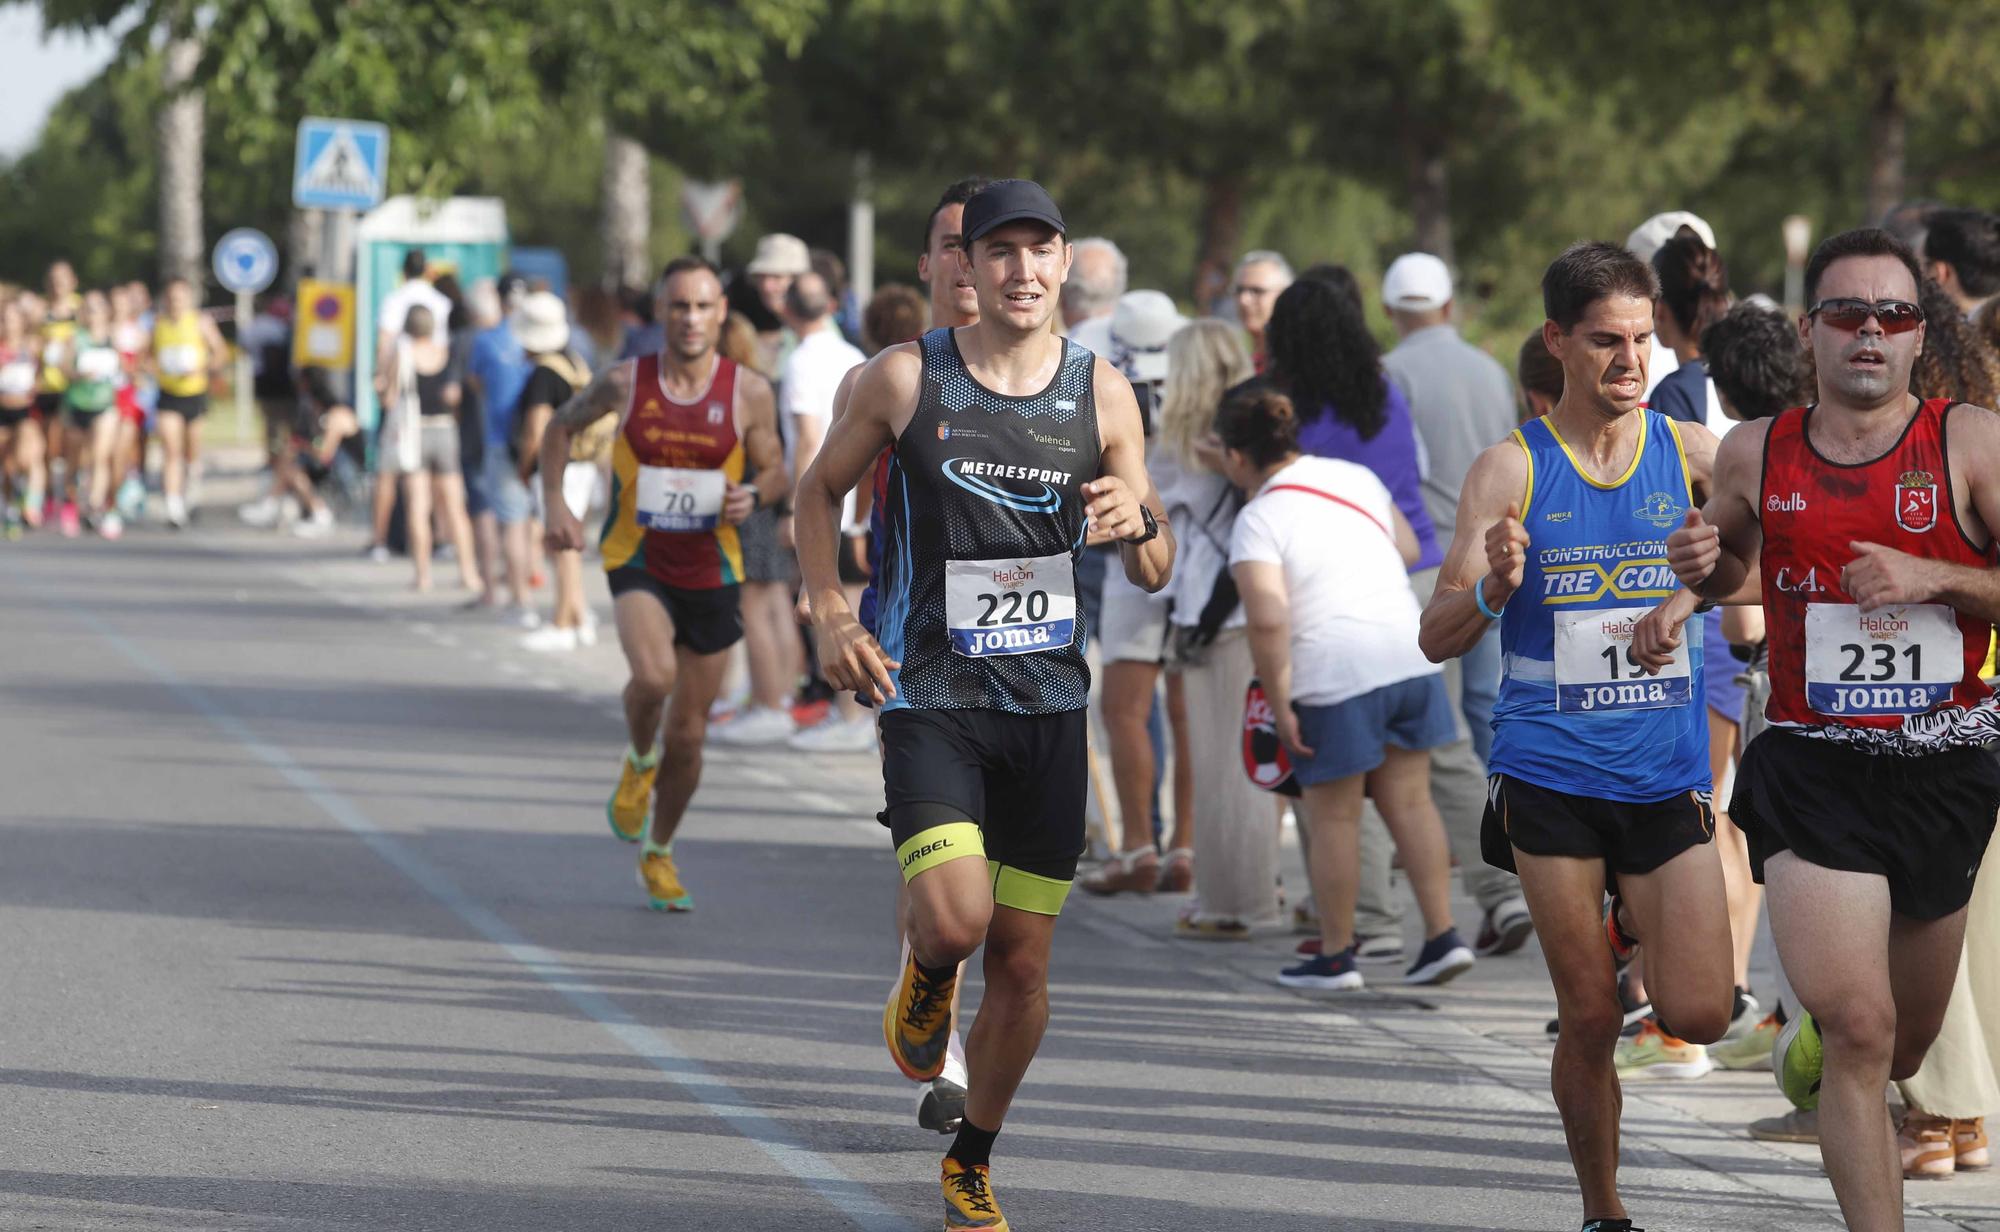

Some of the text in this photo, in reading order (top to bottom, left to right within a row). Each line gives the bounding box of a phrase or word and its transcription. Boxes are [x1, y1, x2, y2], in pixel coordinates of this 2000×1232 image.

[1033, 434, 1071, 446] València
[960, 460, 1072, 486] METAESPORT
[664, 492, 695, 513] 70
[1539, 541, 1668, 564] CONSTRUCCION
[976, 591, 1049, 627] 220
[1839, 644, 1921, 681] 231
